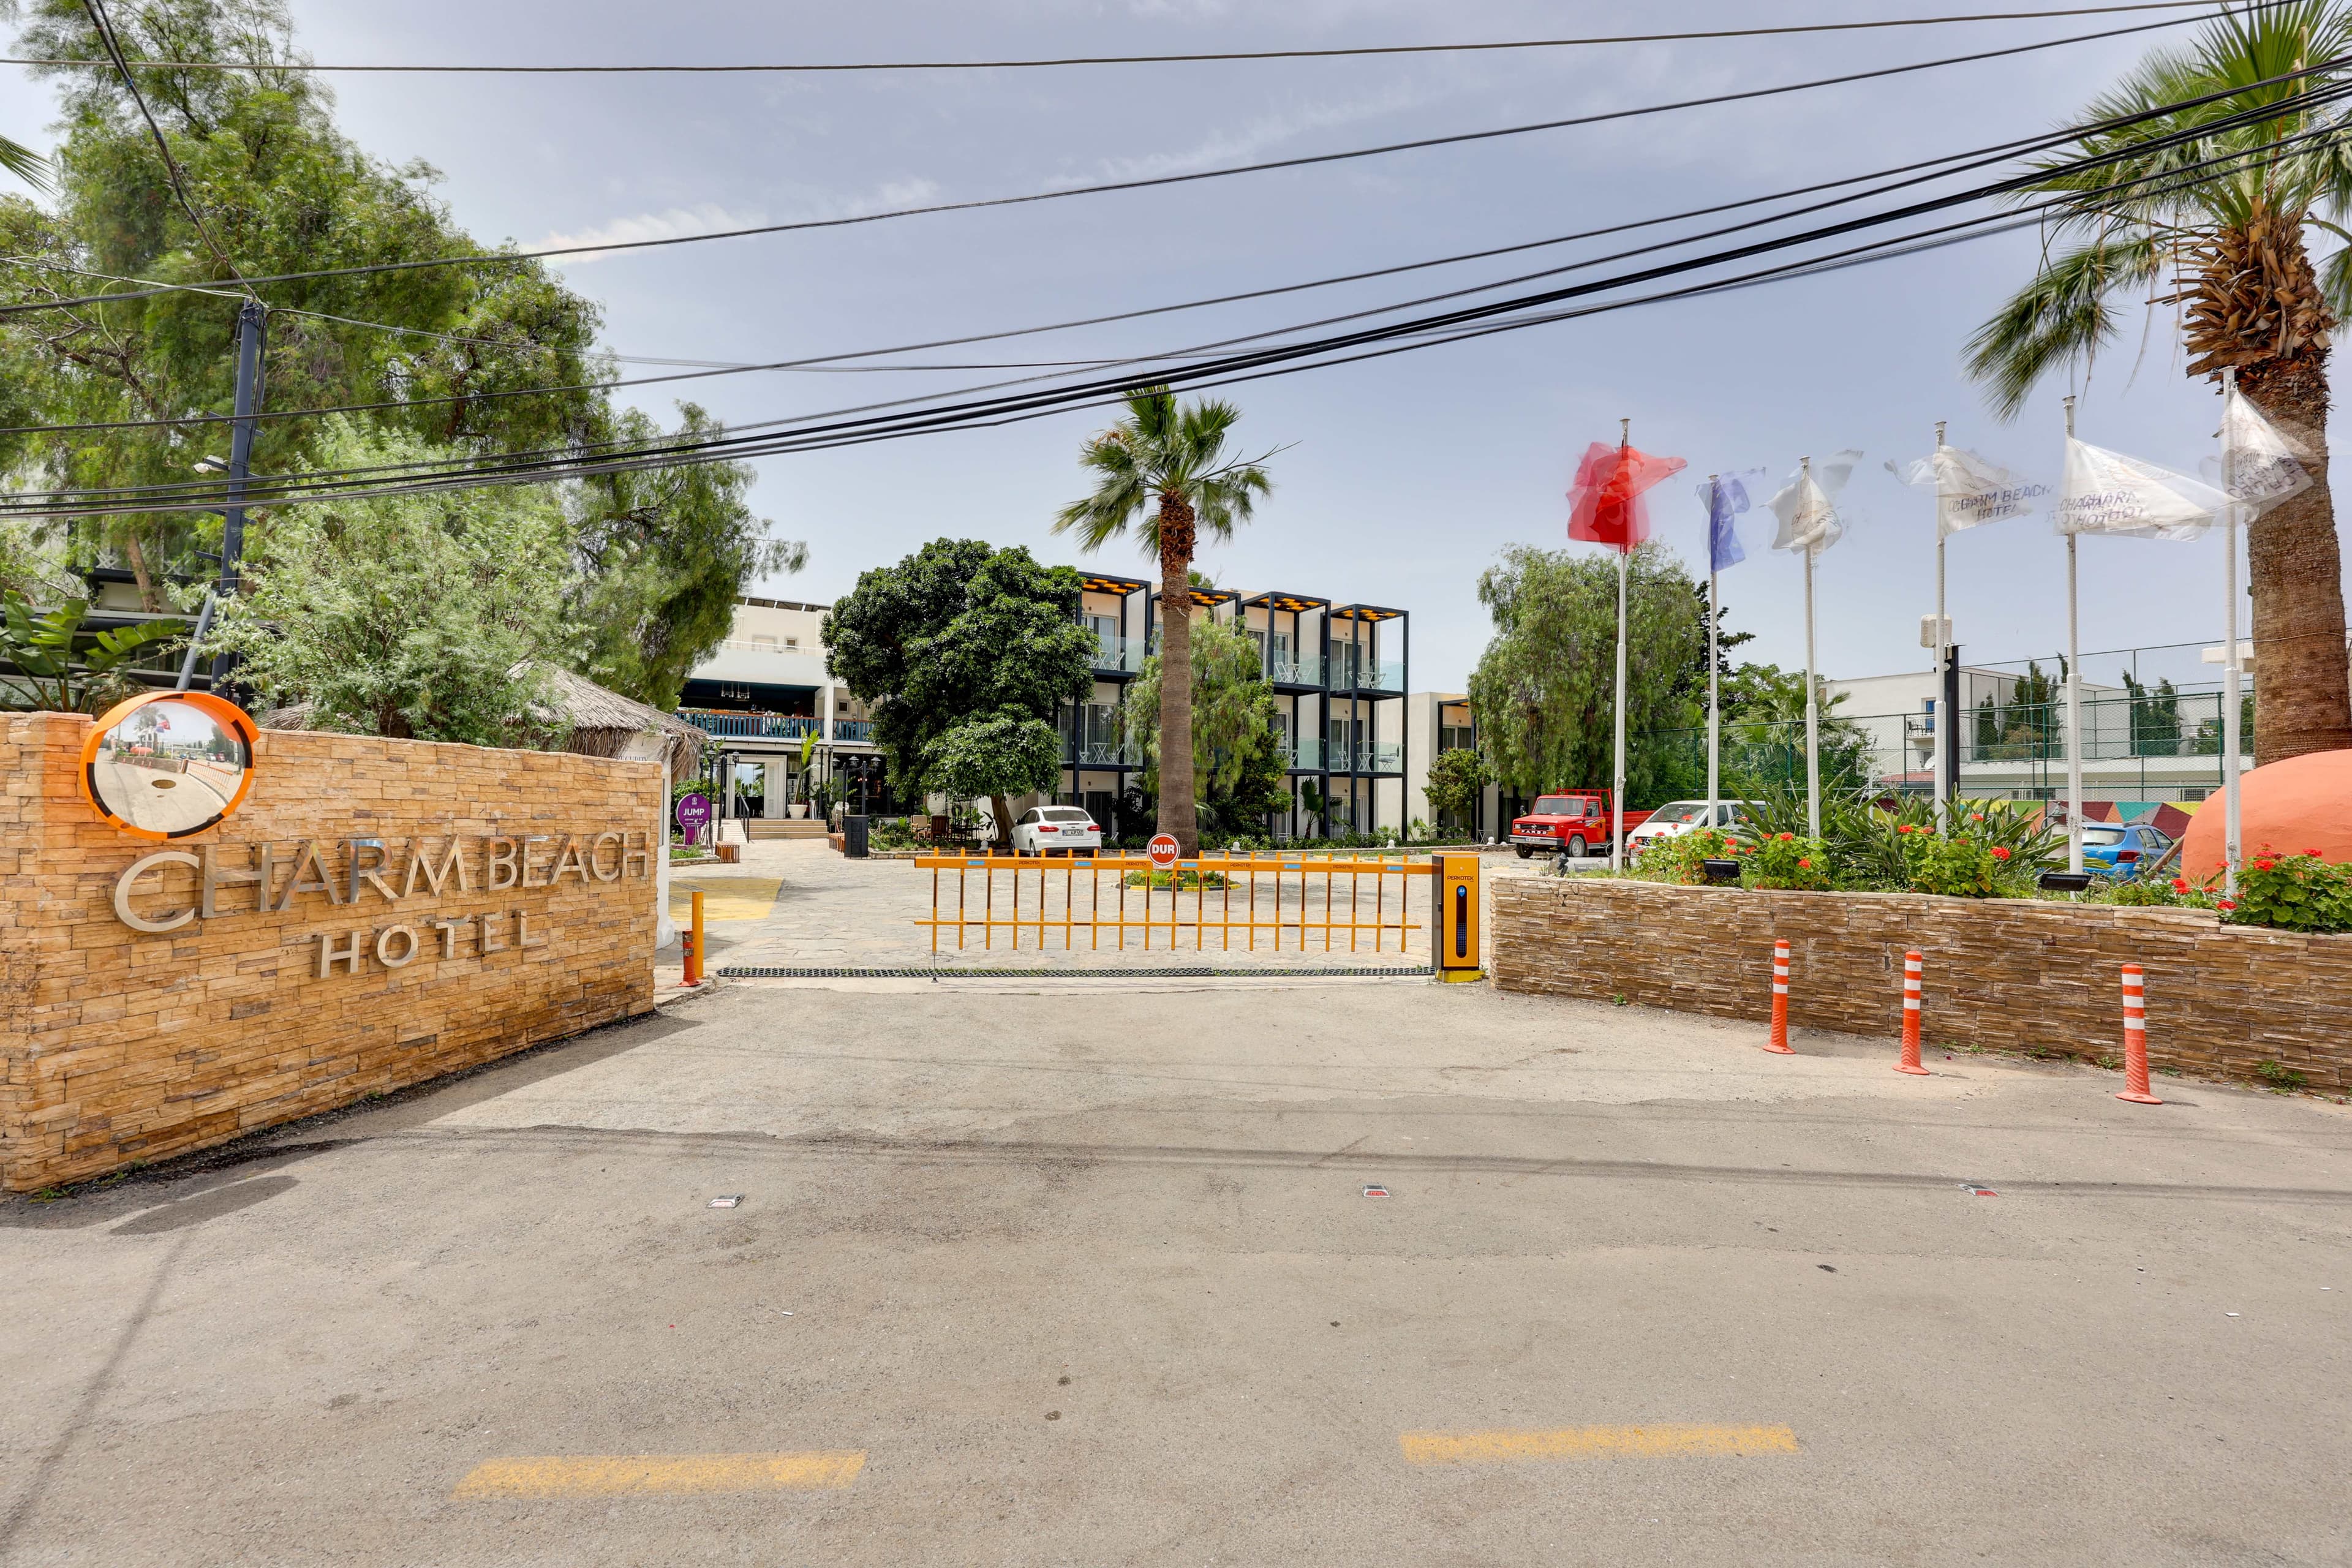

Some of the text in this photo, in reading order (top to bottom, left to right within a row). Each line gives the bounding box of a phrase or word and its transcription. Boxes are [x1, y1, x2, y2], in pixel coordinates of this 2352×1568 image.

[113, 831, 650, 933] CHARM BEACH
[1152, 844, 1175, 854] DUR
[315, 910, 541, 979] HOTEL
